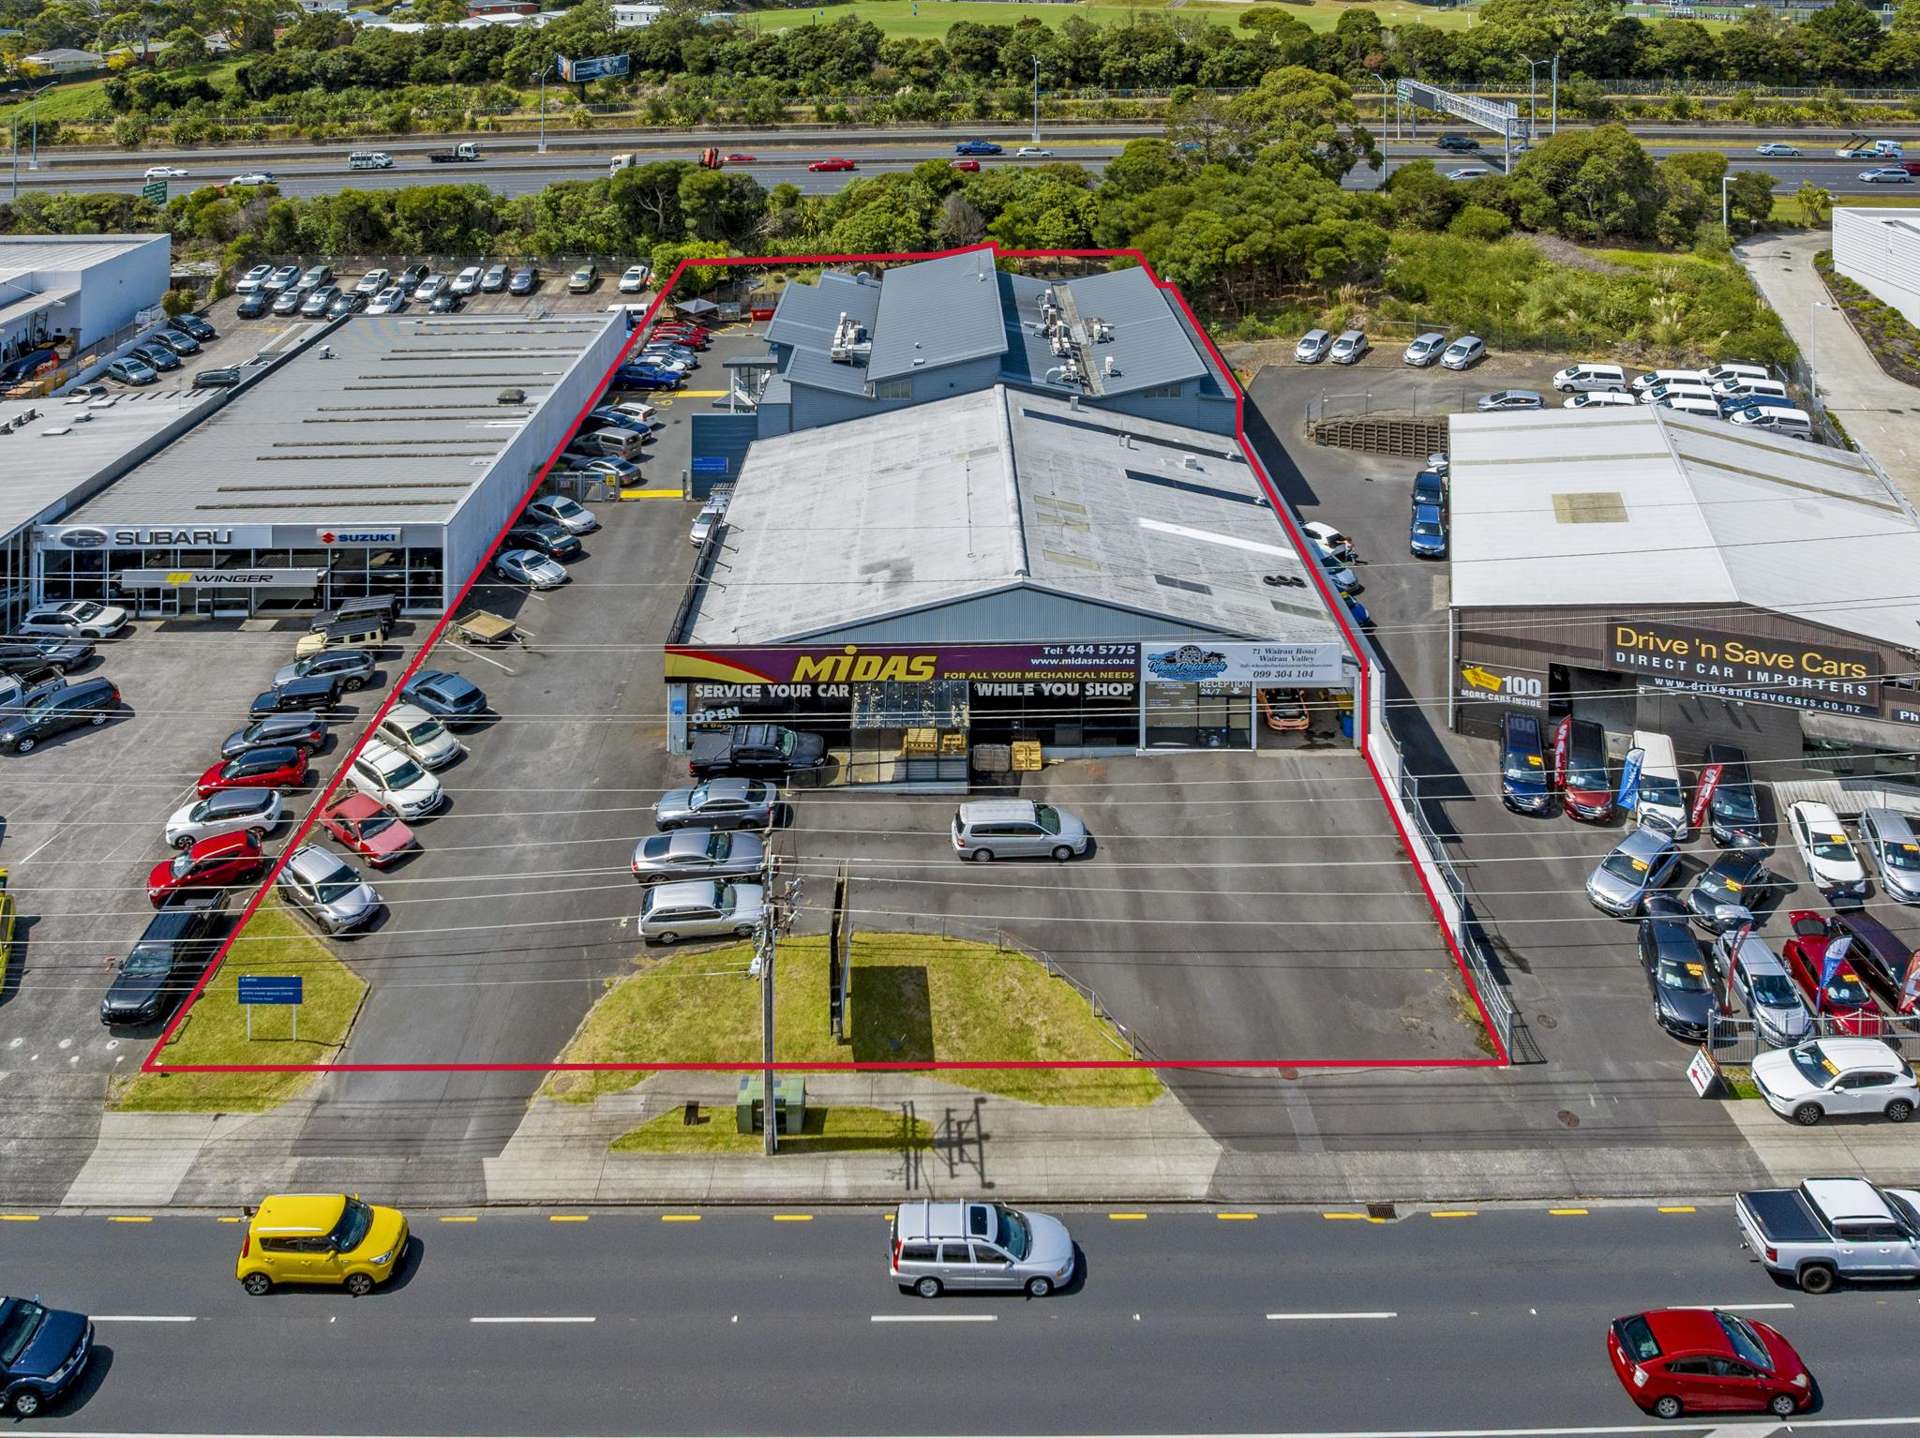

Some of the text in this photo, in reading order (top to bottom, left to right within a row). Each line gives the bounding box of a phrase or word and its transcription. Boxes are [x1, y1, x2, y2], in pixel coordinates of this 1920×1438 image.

[115, 530, 232, 545] SUBARU
[338, 533, 396, 542] SUZUKI
[195, 574, 273, 583] WINGER
[1043, 645, 1136, 655] Tel: 444 5775
[1616, 626, 1867, 679] Drive 'n Save Cars
[1031, 657, 1136, 665] www.midasnz.co.nz
[1291, 655, 1314, 663] Valley
[944, 671, 1136, 680] FOR ALL YOUR MECHANICAL NEEDS
[1616, 652, 1867, 697] DIRECT CAR IMPORTERS
[695, 685, 849, 698] SERVICE YOUR CAR
[976, 683, 1035, 697] WHILE
[1041, 683, 1080, 696] YOU
[1085, 682, 1135, 696] SHOP
[1502, 676, 1542, 697] 100
[1461, 689, 1543, 707] MORE CARS INSIDE
[1654, 678, 1861, 714] www.driveandsavecars.co.nz
[691, 706, 740, 723] OPEN
[1900, 710, 1920, 722] Ph
